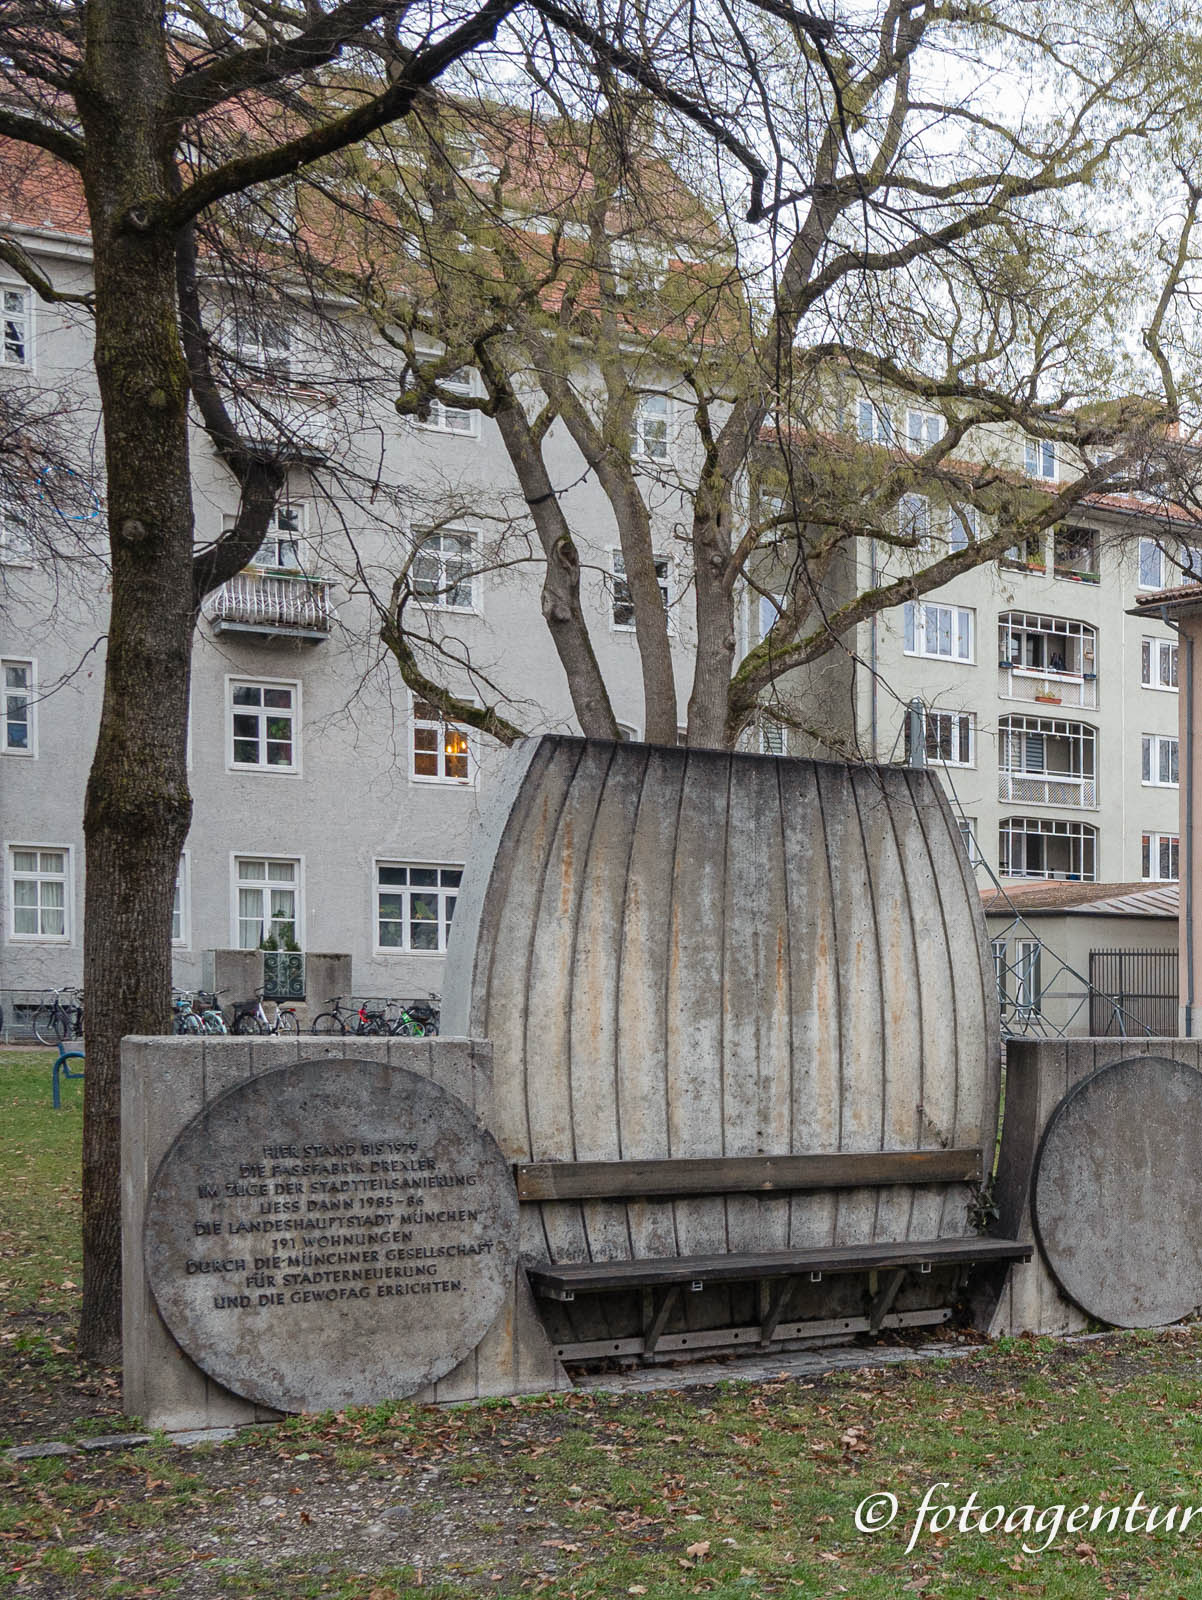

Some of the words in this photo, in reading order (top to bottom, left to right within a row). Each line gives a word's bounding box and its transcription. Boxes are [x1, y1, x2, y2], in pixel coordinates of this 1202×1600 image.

[263, 1144, 298, 1159] HIER
[303, 1143, 357, 1158] STAND
[361, 1142, 384, 1156] BIS
[386, 1141, 419, 1155] 1979
[240, 1163, 266, 1179] DIE
[370, 1158, 441, 1173] DREXLER.
[199, 1183, 219, 1199] IM
[225, 1182, 268, 1197] ZUGE
[274, 1182, 304, 1196] DER
[310, 1173, 477, 1194] STADTTEILSANIERUNG
[307, 1197, 355, 1213] DANN
[194, 1220, 222, 1236] DIE
[228, 1213, 394, 1234] LANDESHAUPTSTADT
[400, 1208, 478, 1225] MÜNCHEN
[271, 1237, 296, 1250] 191
[302, 1230, 413, 1248] WOHNUNGEN
[186, 1258, 246, 1275] DURCH
[254, 1256, 281, 1271] DIE
[287, 1250, 379, 1268] MÜNCHNER
[385, 1241, 494, 1261] GESELLSCHAFT
[246, 1271, 276, 1289] FÜR
[282, 1264, 437, 1287] STADTERNEUERUNG
[214, 1295, 251, 1310] UND
[258, 1292, 285, 1307] DIE
[290, 1286, 371, 1304] GEWOFAG
[377, 1279, 467, 1297] ERRICHTEN.
